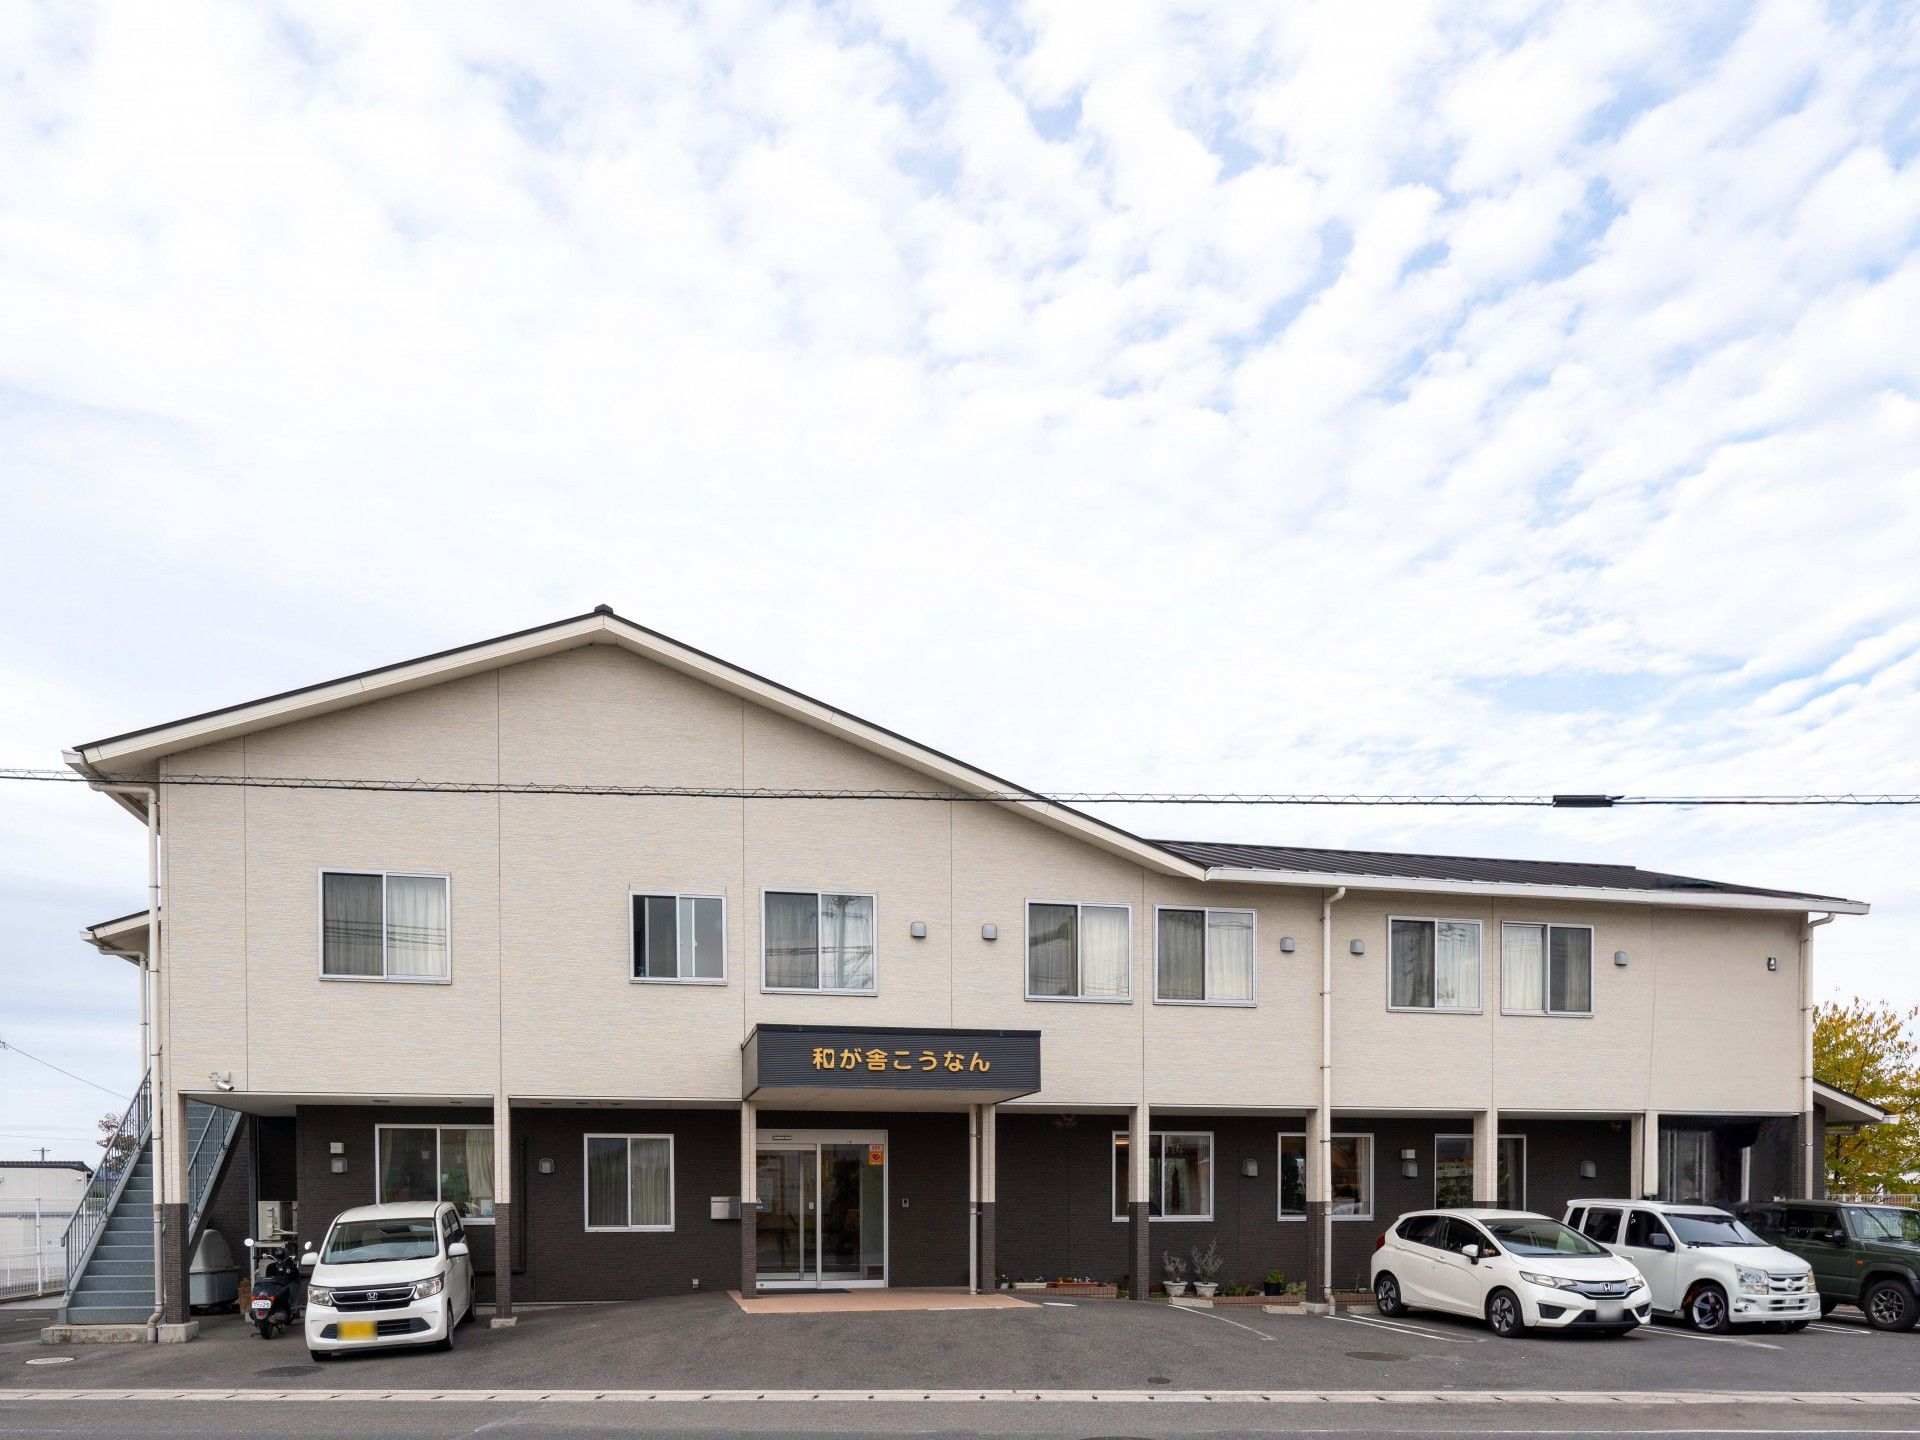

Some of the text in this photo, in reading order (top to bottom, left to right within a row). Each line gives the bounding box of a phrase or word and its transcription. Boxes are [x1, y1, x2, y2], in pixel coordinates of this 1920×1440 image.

[812, 1047, 990, 1072] 和が舎こうなん
